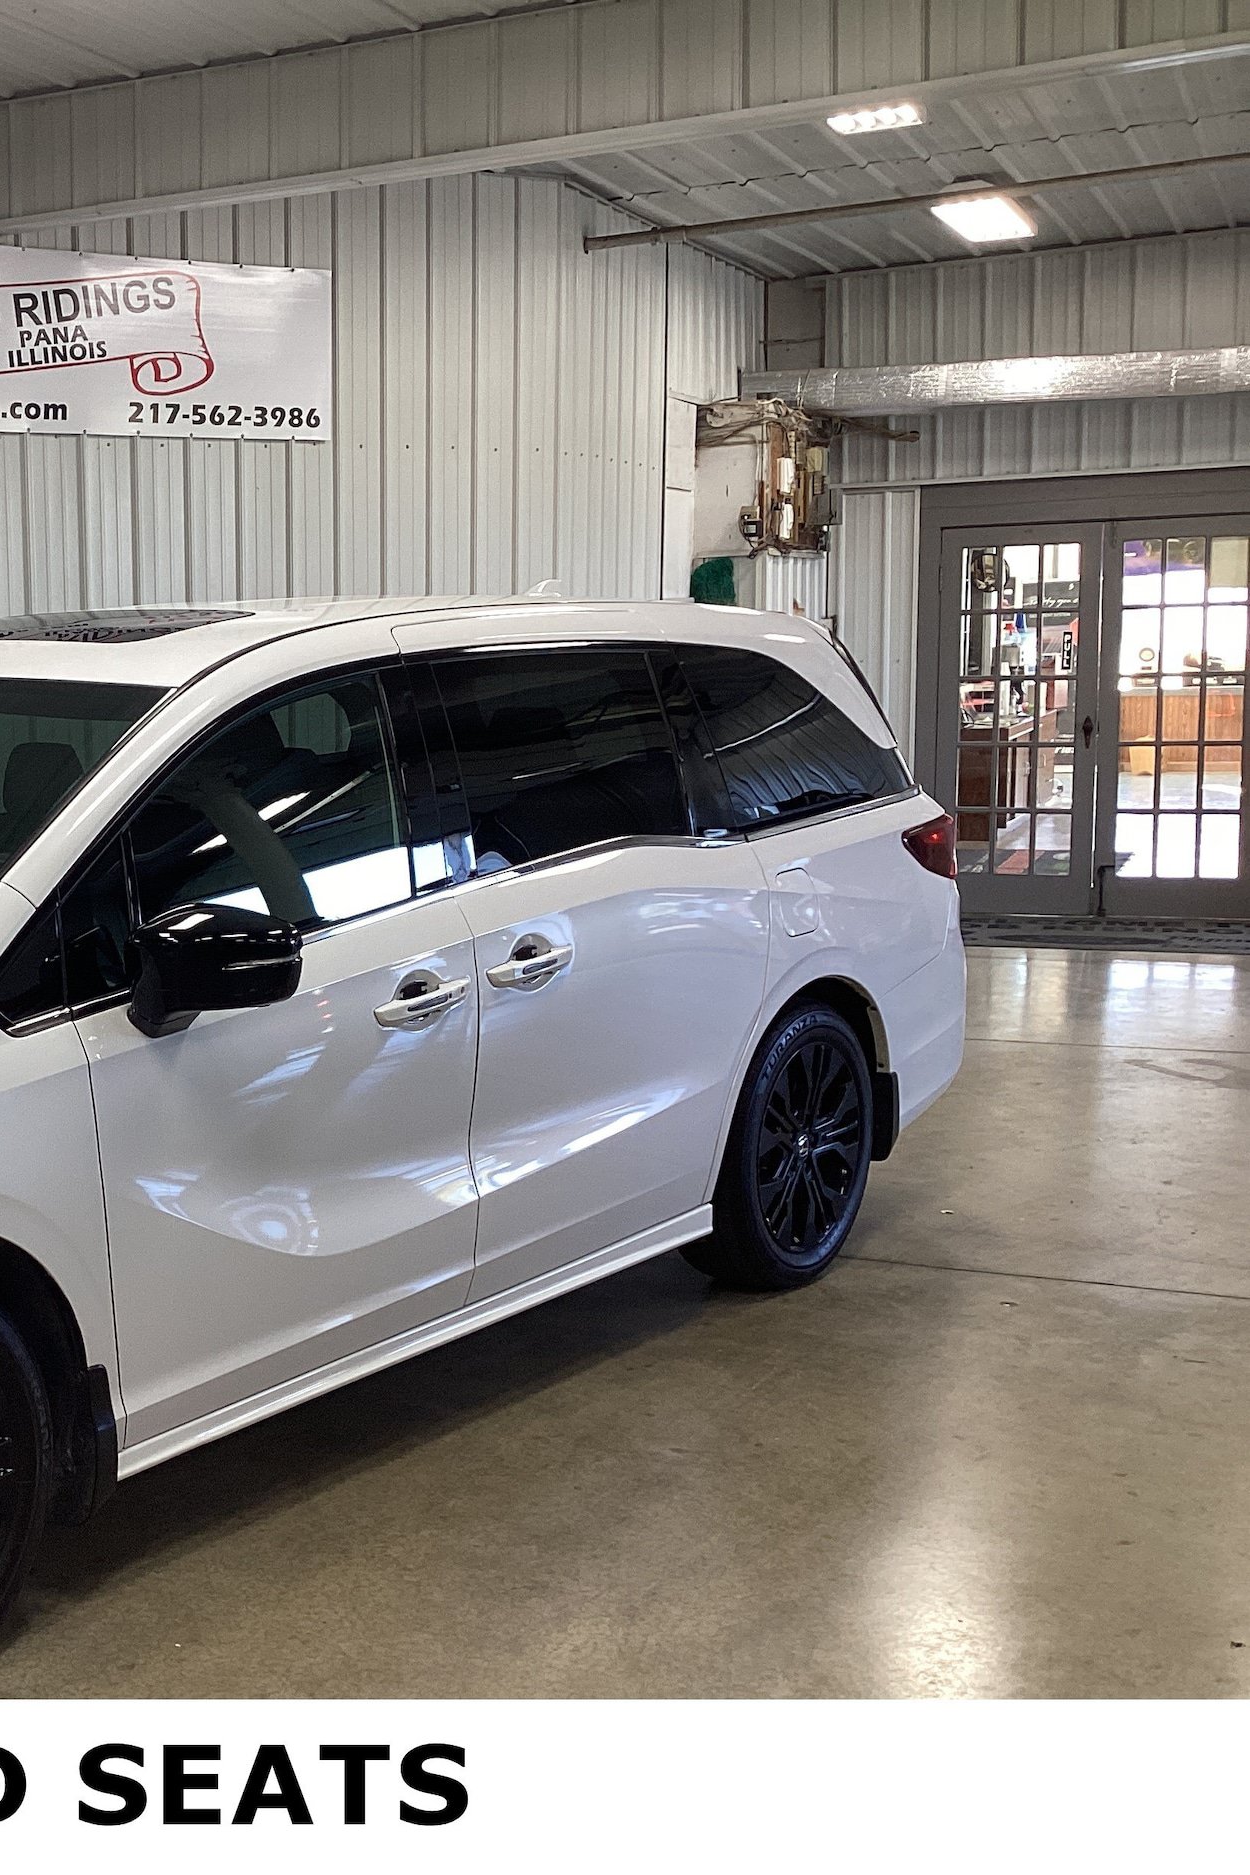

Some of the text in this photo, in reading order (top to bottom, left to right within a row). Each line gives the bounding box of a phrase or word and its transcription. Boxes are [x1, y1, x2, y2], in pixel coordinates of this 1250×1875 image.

[14, 276, 176, 328] RIDINGS
[19, 325, 89, 348] PANA
[7, 340, 108, 369] ILLINOIS
[128, 401, 322, 428] 217-562-3986
[1063, 634, 1071, 668] PULL
[761, 1015, 818, 1079] TURANZA
